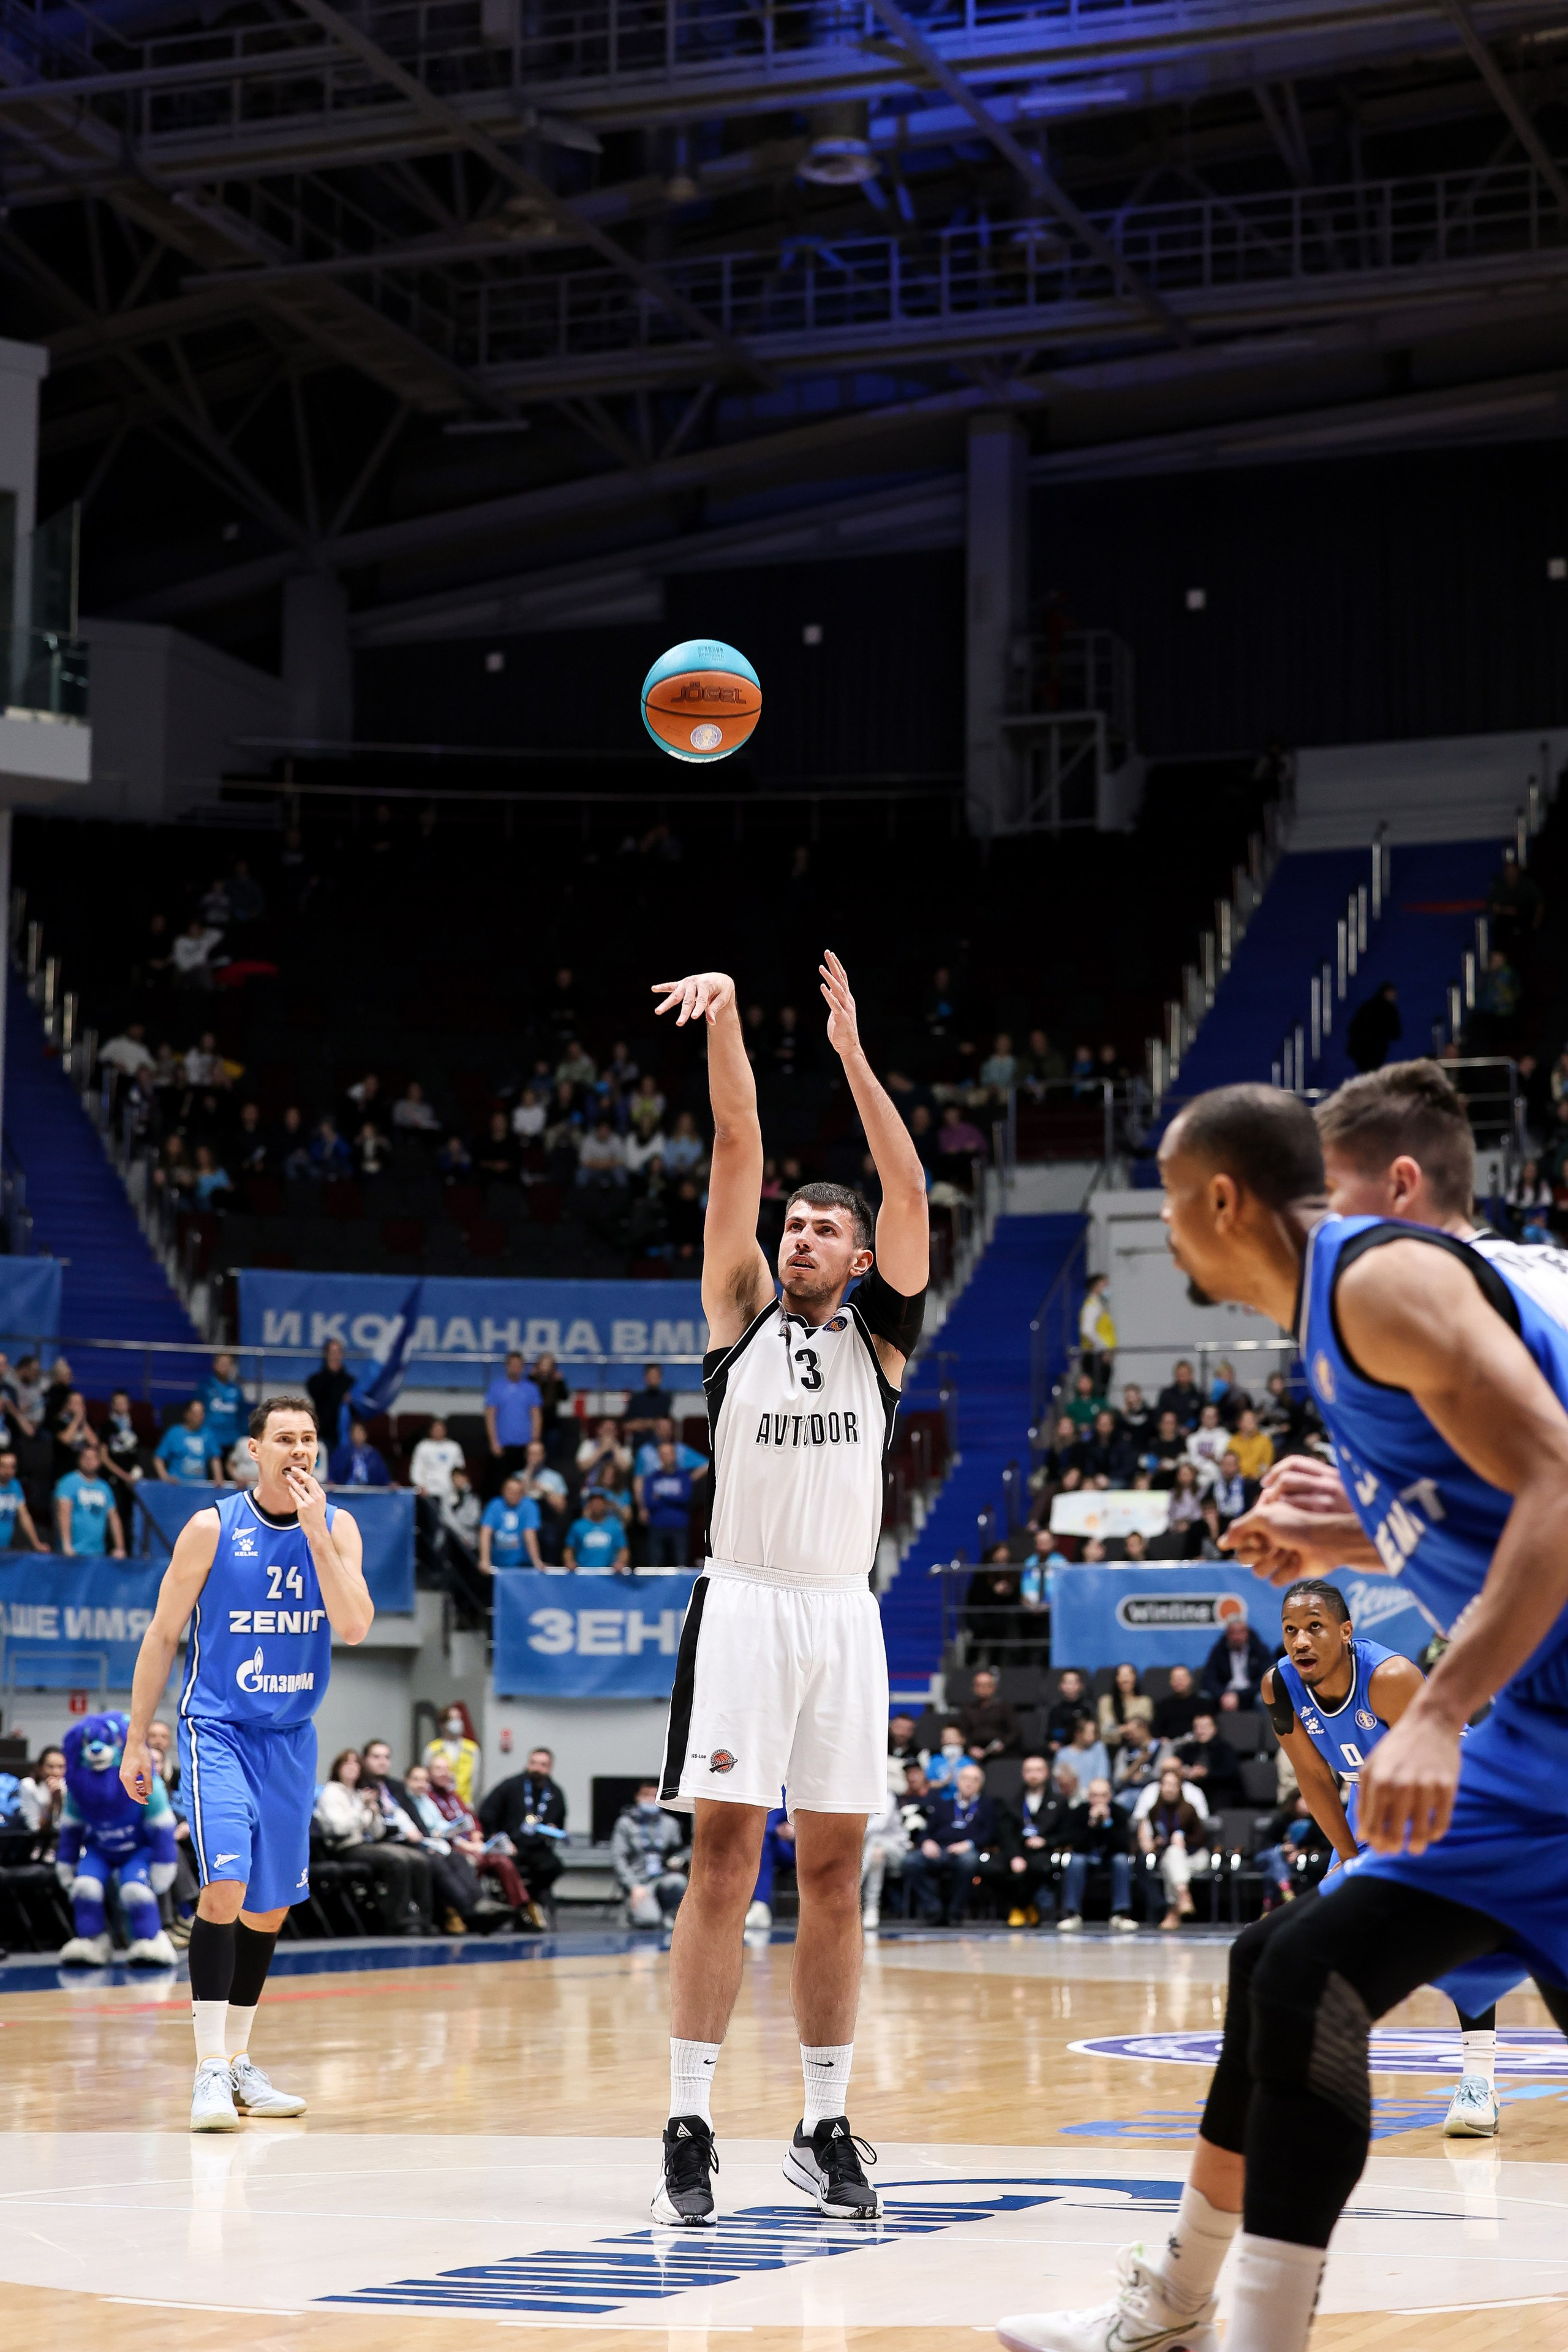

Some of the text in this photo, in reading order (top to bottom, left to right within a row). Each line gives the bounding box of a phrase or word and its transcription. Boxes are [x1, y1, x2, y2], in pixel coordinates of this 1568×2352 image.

[671, 681, 747, 704] JÖGEL
[262, 1309, 302, 1346] И
[794, 1348, 824, 1392] 3
[266, 1565, 304, 1600] 24
[64, 1605, 154, 1642] ИМЯ
[229, 1609, 326, 1634] ZENIT
[527, 1607, 686, 1656] ЗЕН
[1340, 1743, 1365, 1767] 0
[310, 2206, 997, 2313] GAZPROM
